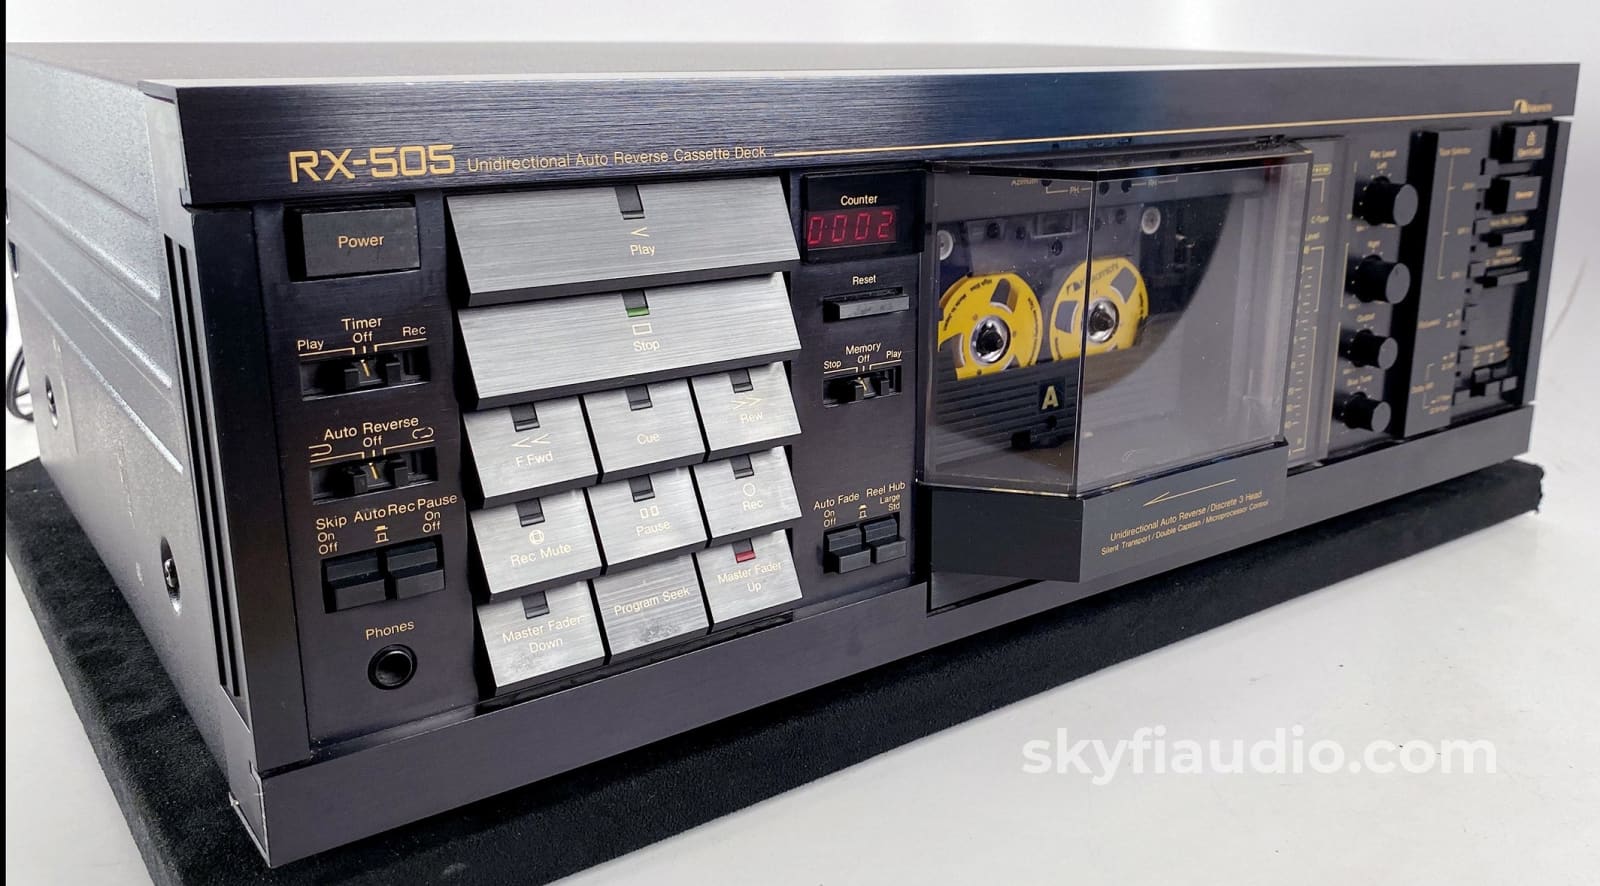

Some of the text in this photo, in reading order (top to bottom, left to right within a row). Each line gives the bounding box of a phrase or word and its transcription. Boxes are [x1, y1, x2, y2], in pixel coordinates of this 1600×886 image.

[288, 144, 457, 183] RX-505
[467, 145, 767, 173] Unidirectional Auto Reverse Cassette Deck
[840, 194, 878, 206] Counter
[807, 211, 894, 245] 0002
[337, 233, 385, 250] Power
[630, 244, 656, 257] Play
[852, 274, 878, 286] Reset
[341, 317, 383, 332] Timer
[402, 325, 427, 337] Rec
[352, 331, 374, 344] Off
[297, 339, 325, 351] Play
[633, 340, 661, 353] Stop
[845, 342, 882, 356] Memory
[857, 354, 871, 364] Off
[886, 349, 902, 359] Play
[823, 360, 842, 370] Stop
[1042, 385, 1059, 410] A
[740, 410, 763, 423] Rew
[324, 416, 419, 441] Auto Reverse
[362, 435, 383, 448] Off
[637, 431, 661, 445] Cue
[866, 480, 906, 498] Reel Hub
[742, 499, 764, 512] Rec
[813, 492, 860, 511] Auto Fade
[880, 494, 901, 505] Large
[353, 494, 458, 524] Auto Rec Pause
[888, 502, 900, 511] Std
[424, 510, 441, 521] On
[823, 509, 835, 519] On
[1110, 519, 1159, 542] Unidirectional
[1160, 515, 1178, 528] Auto
[1239, 495, 1244, 504] 3
[1245, 490, 1263, 503] Head
[315, 514, 348, 531] Skip
[422, 521, 441, 534] Off
[636, 519, 672, 537] Pause
[823, 518, 836, 528] Off
[317, 531, 335, 544] On
[318, 542, 338, 555] Off
[1100, 543, 1120, 556] Silent
[510, 543, 572, 568] Rec Mute
[717, 560, 783, 585] Master Fader
[747, 580, 762, 594] Up
[613, 585, 691, 618] Program Seek
[365, 620, 416, 641] Phones
[502, 614, 582, 644] Master Fader
[529, 637, 564, 654] Down
